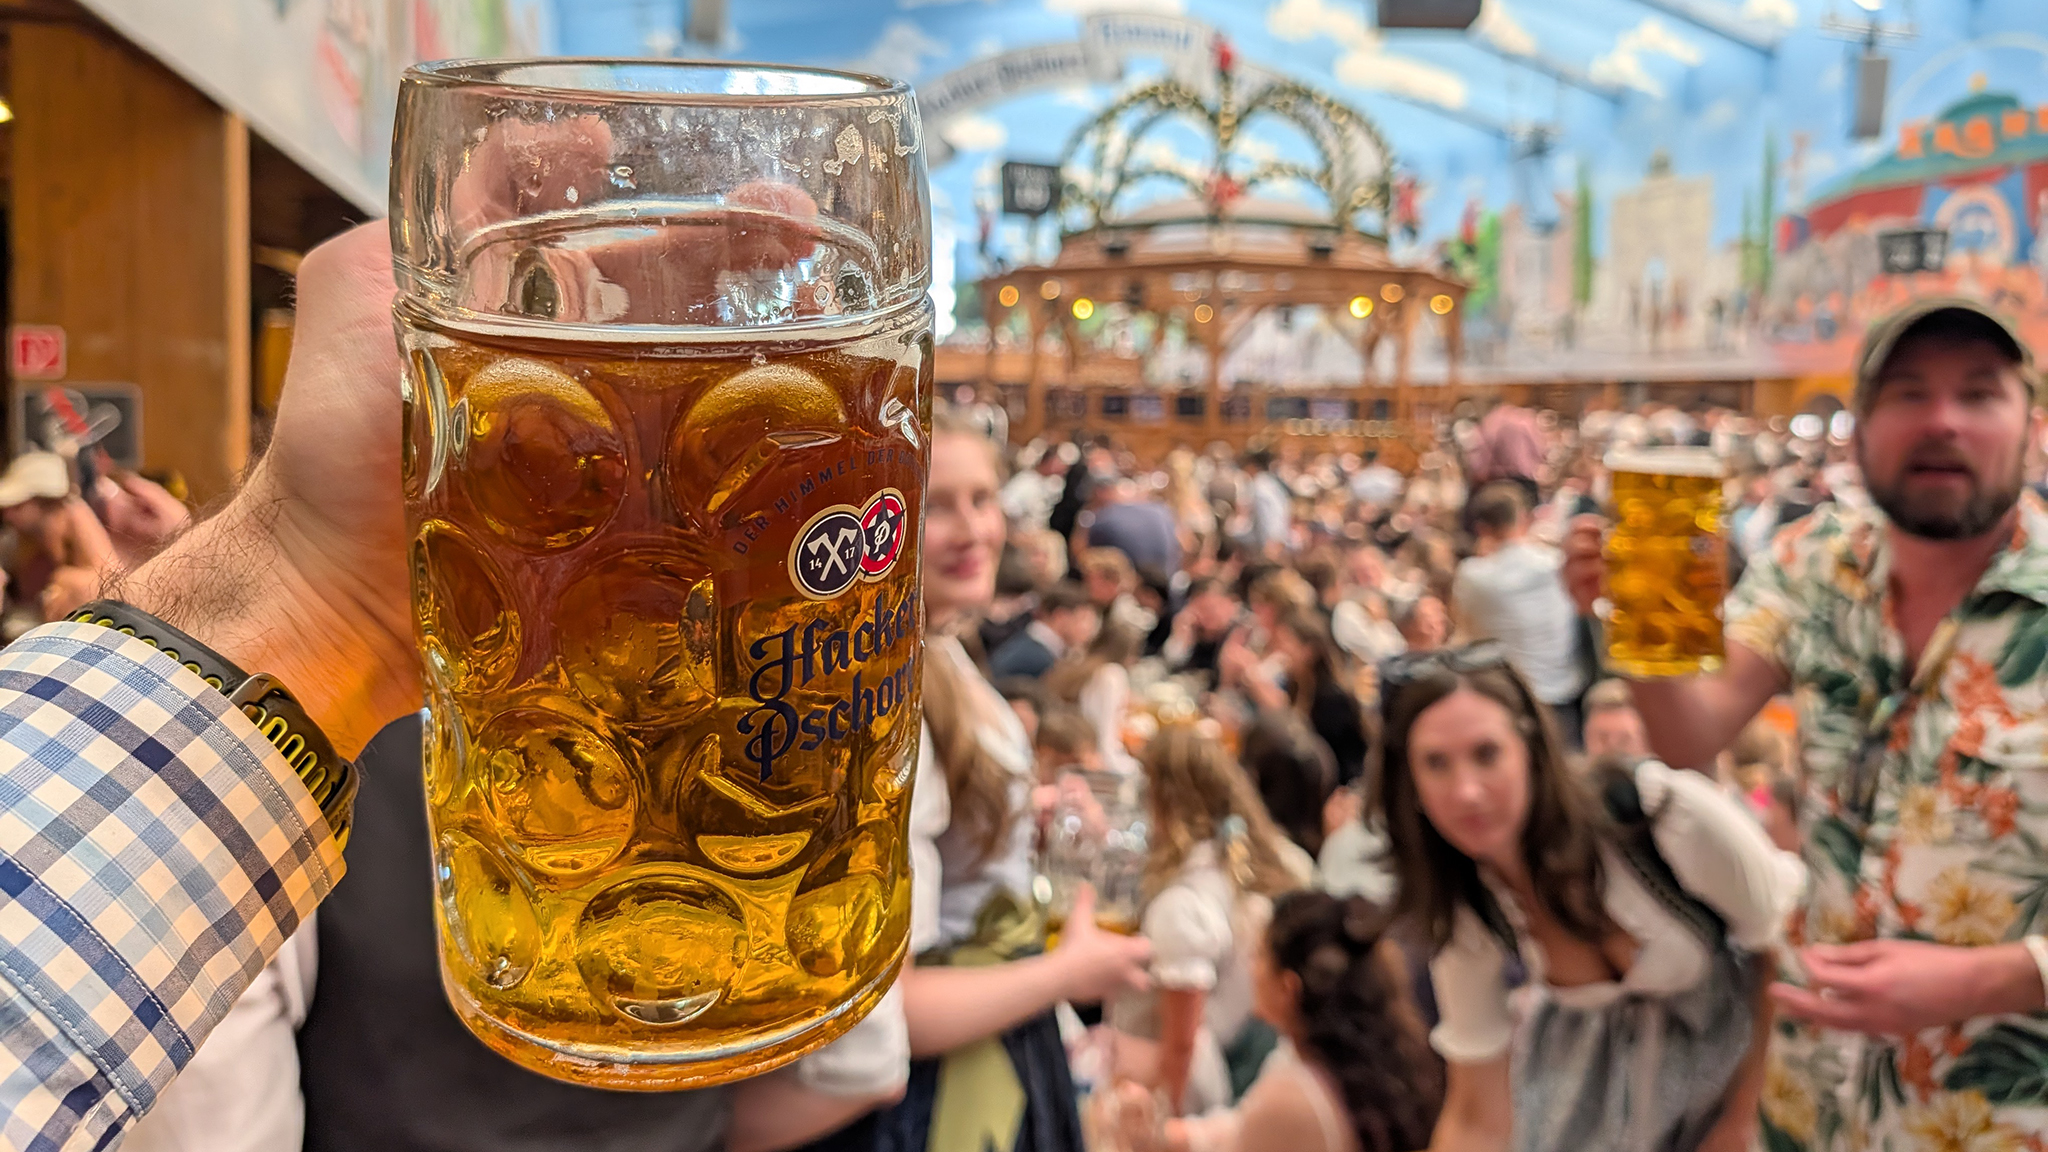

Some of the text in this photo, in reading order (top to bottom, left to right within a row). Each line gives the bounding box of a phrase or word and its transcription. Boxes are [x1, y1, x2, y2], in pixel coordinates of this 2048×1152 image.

[733, 515, 771, 555] DER
[774, 456, 857, 513] HIMMEL
[868, 448, 894, 466] DER
[809, 547, 856, 571] 14 17
[749, 590, 916, 702] Hacker
